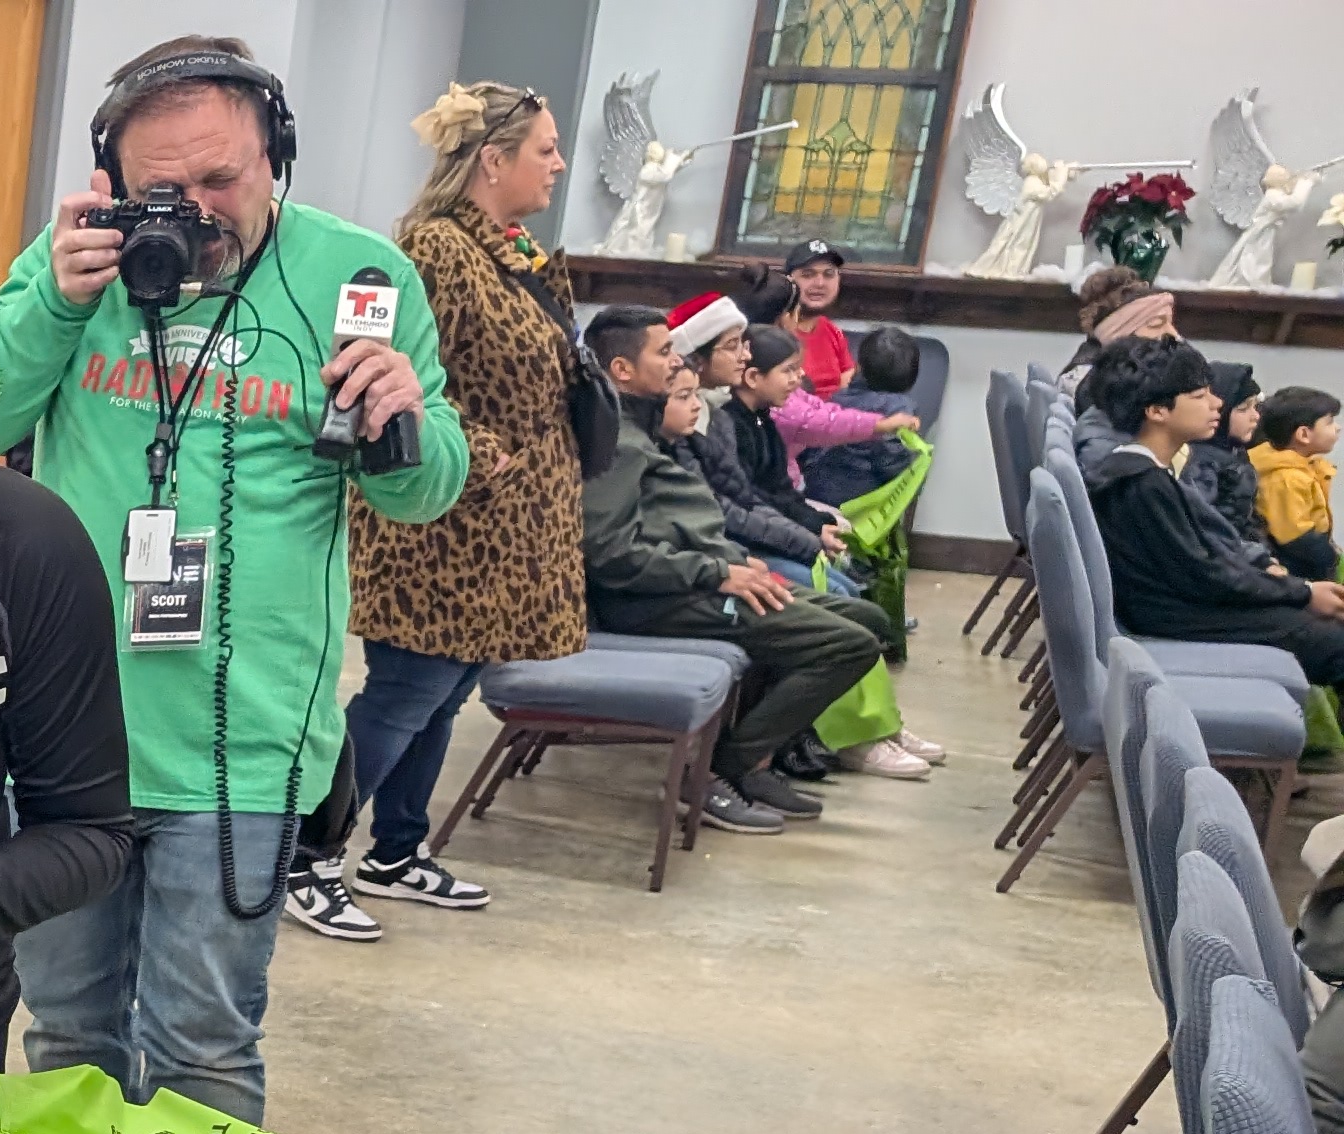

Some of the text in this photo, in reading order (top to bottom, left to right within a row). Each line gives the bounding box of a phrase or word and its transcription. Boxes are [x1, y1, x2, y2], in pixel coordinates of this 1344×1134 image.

[137, 57, 227, 80] STUDIO MONITOR
[369, 306, 389, 319] 19
[341, 318, 389, 329] TELEMUNDO
[110, 396, 132, 408] FOR
[134, 401, 151, 411] THE
[151, 594, 187, 606] SCOTT
